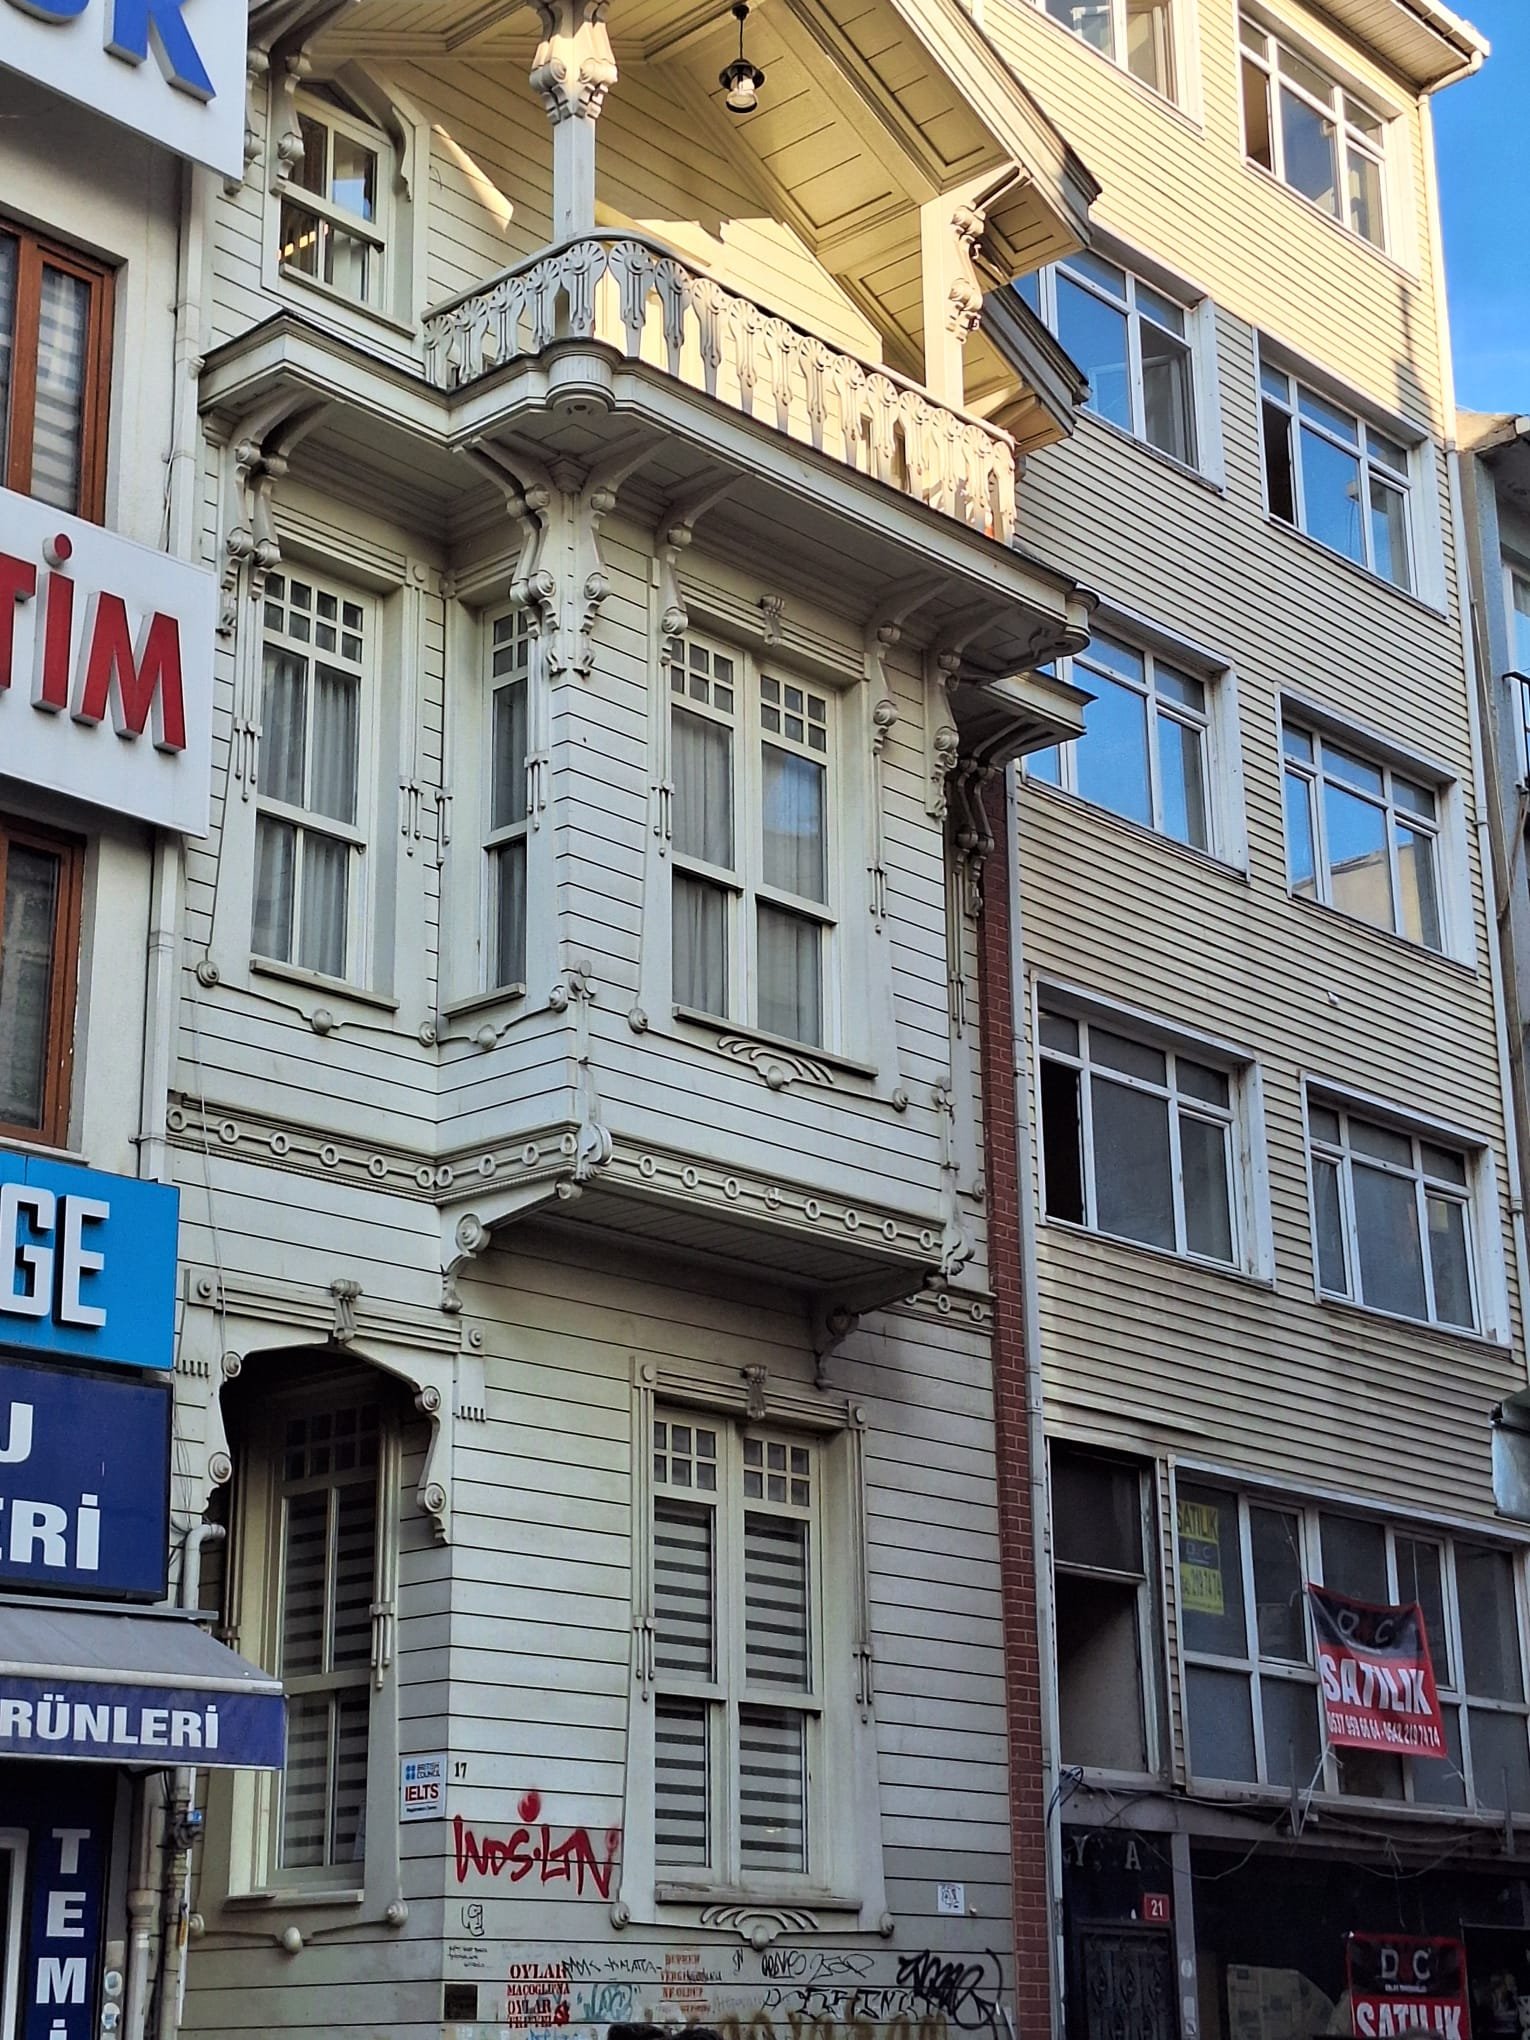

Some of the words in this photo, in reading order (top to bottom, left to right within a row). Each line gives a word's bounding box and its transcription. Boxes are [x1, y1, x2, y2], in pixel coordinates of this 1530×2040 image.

[0, 1183, 110, 1328] GE
[0, 1493, 100, 1570] Rİ
[1320, 1654, 1433, 1715] SATILIK
[0, 1694, 219, 1748] RÜNLERİ
[405, 1783, 439, 1802] IELTS
[455, 1761, 467, 1778] 17
[1151, 1899, 1163, 1917] 21
